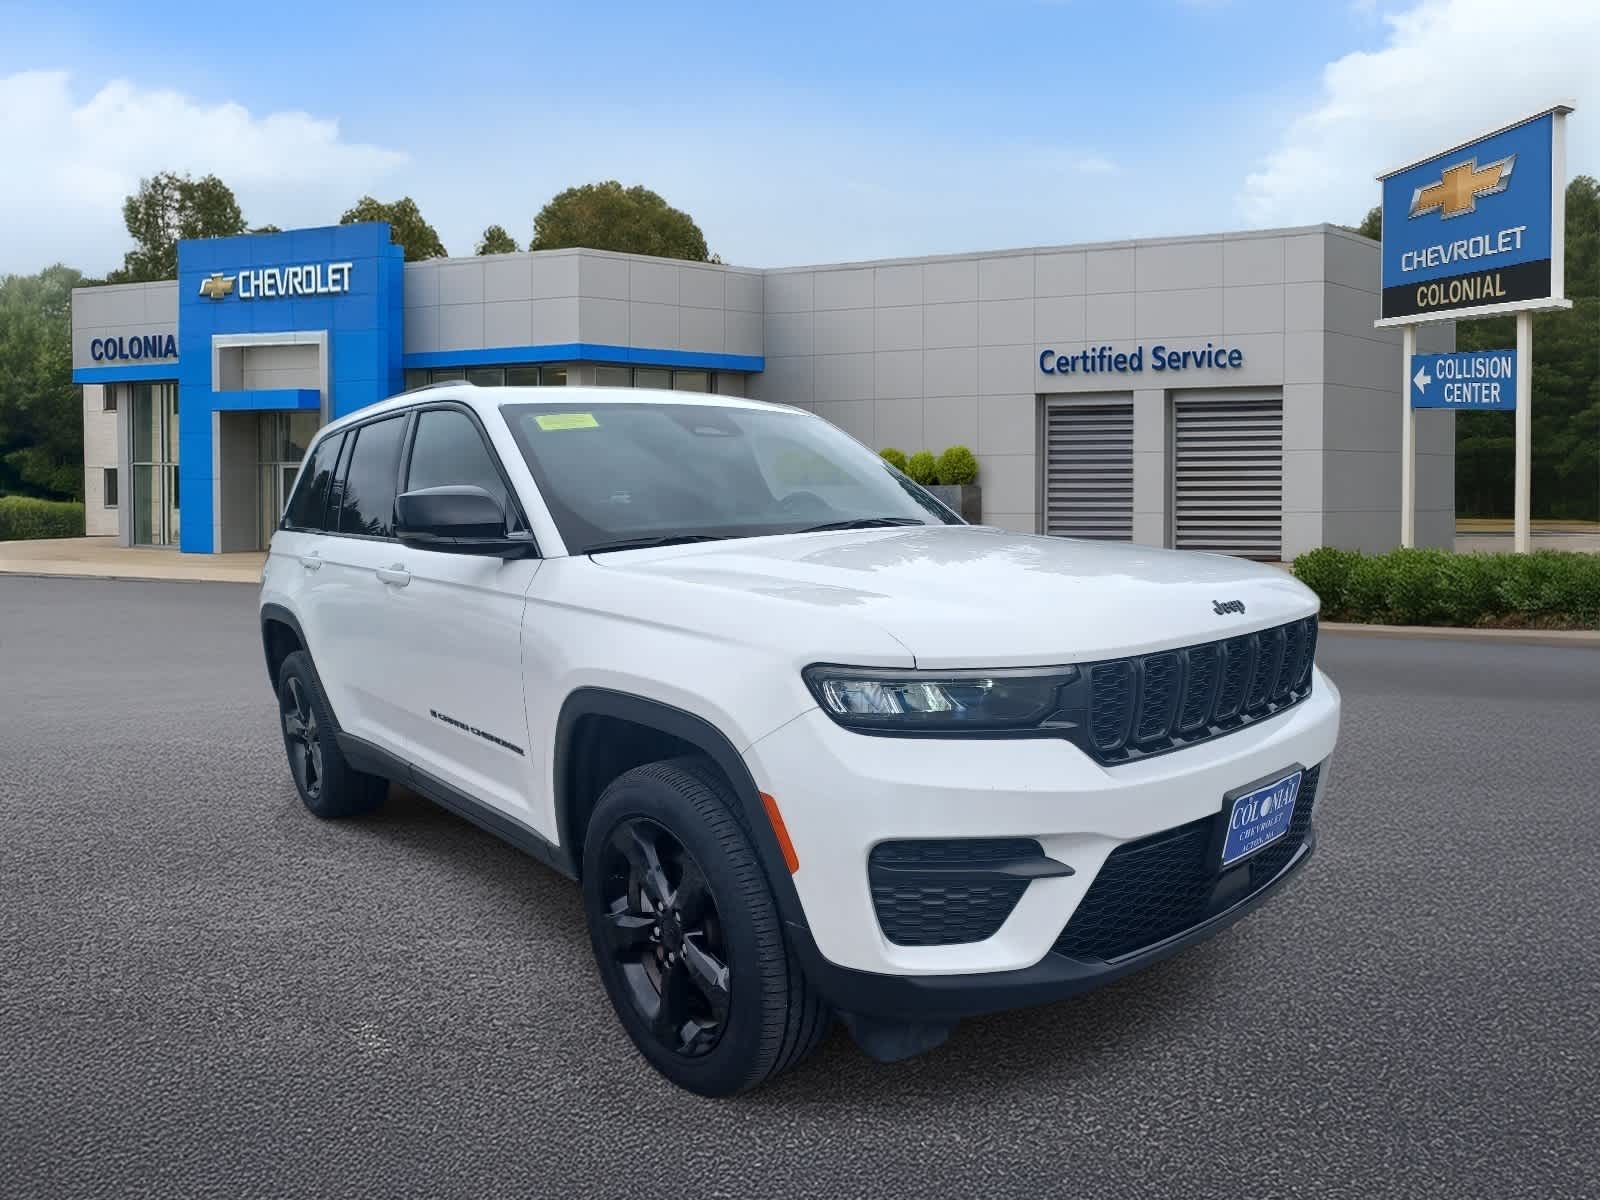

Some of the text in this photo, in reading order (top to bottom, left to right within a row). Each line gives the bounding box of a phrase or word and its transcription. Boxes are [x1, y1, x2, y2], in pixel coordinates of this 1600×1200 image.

[1401, 225, 1527, 272] CHEVROLET
[238, 262, 352, 298] CHEVROLET
[1416, 273, 1506, 307] COLONIAL
[1039, 343, 1243, 374] Certified Service
[1436, 356, 1512, 379] COLLISION
[1444, 382, 1500, 403] CENTER
[1212, 599, 1246, 615] Jeep
[1239, 812, 1284, 841] CHEVROLET
